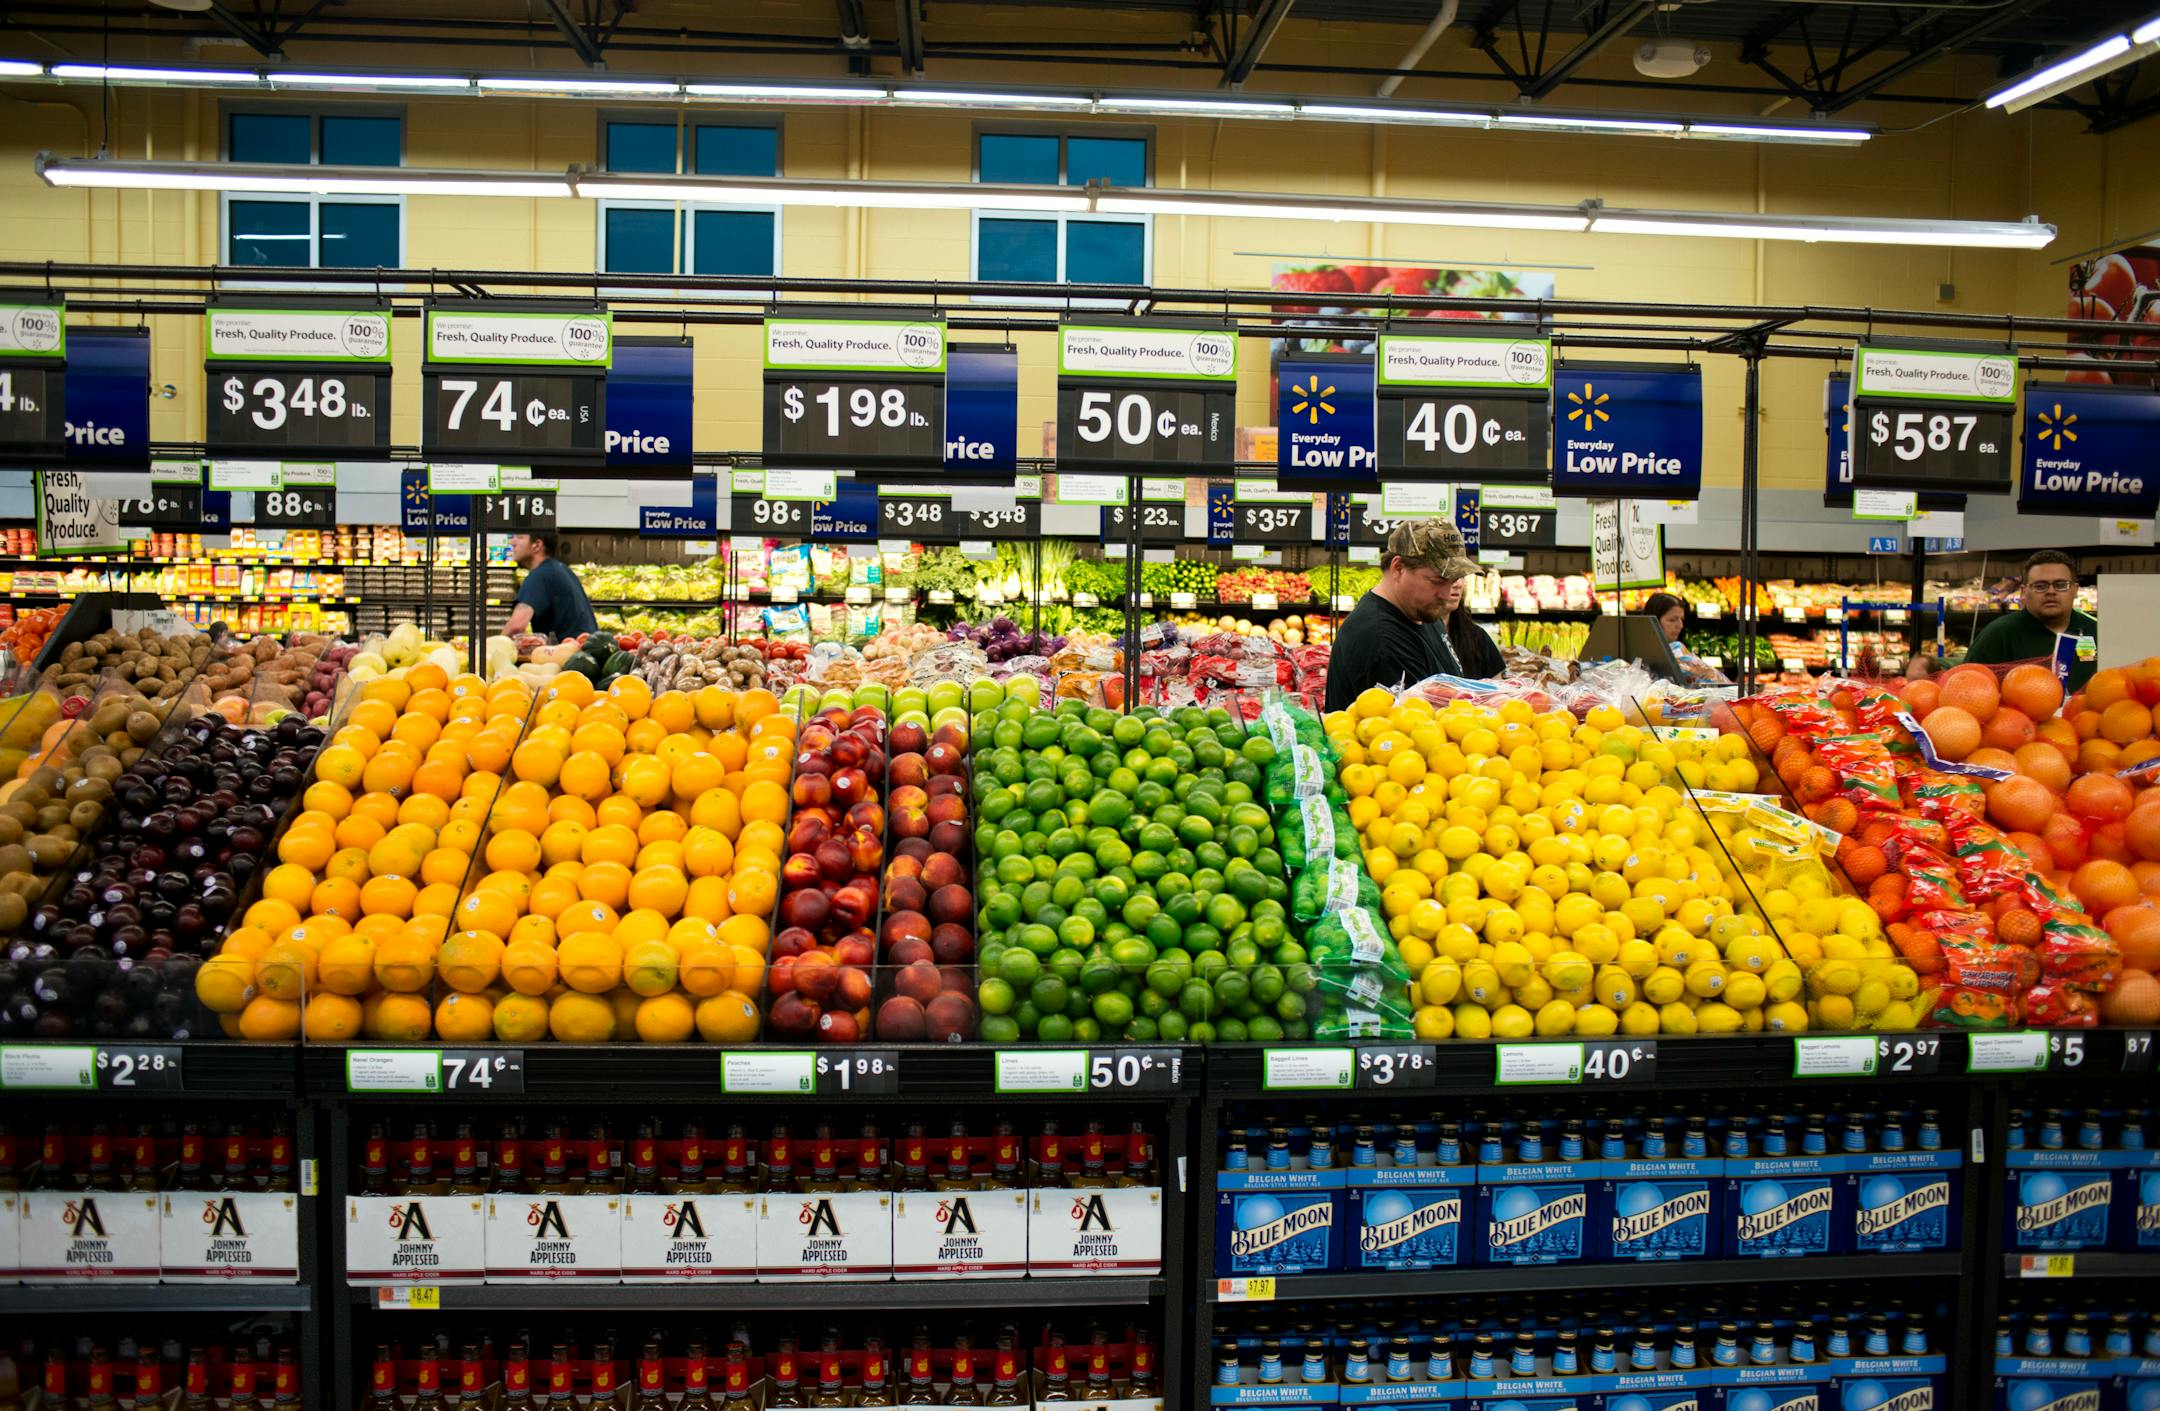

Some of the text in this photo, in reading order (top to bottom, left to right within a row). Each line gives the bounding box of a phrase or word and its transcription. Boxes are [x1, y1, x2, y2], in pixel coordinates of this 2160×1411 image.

[20, 317, 57, 333] 100%
[349, 324, 385, 340] 100%
[215, 328, 336, 342] Fresh, Quality Produce.
[436, 332, 557, 346] Fresh, Quality Produce.
[569, 327, 604, 344] 100%
[904, 334, 939, 350] 100%
[772, 338, 892, 352] Fresh, Quality Produce.
[1067, 344, 1184, 358] Fresh, Quality Produce.
[1196, 342, 1231, 358] 100%
[1388, 355, 1500, 368] Fresh, Quality Produce.
[1512, 352, 1544, 367] 100%
[1866, 366, 1970, 382] Fresh, Quality Produce.
[1980, 366, 2012, 381] 100%
[352, 403, 372, 418] lb.
[548, 407, 570, 421] ea.
[580, 405, 589, 424] USA
[910, 412, 929, 427] lb.
[1181, 424, 1202, 436] ea.
[1210, 412, 1219, 442] Mexico
[605, 430, 670, 454] Price
[1292, 433, 1340, 446] Everyday
[1505, 429, 1526, 441] ea.
[946, 436, 994, 460] rice
[1568, 440, 1614, 452] Everyday
[1979, 442, 1998, 454] ea.
[1291, 445, 1344, 467] Low
[1567, 452, 1682, 475] Low Price
[2036, 458, 2080, 471] Everyday
[2034, 470, 2144, 495] Low Price
[45, 494, 90, 516] Quality
[436, 514, 468, 526] Price
[646, 518, 706, 530] Low Price
[836, 521, 868, 533] Price
[1596, 512, 1618, 530] Fresh
[1872, 538, 1882, 550] A
[1172, 1058, 1181, 1084] Mexico
[1873, 1154, 1935, 1164] BELGIAN WHITE
[2033, 1152, 2098, 1162] BELGIAN WHITE
[1507, 1166, 1572, 1176] BELGIAN WHITE
[1630, 1162, 1696, 1172] BELGIAN WHITE
[1755, 1160, 1819, 1170] BELGIAN WHITE
[1248, 1174, 1318, 1183] BELGIAN WHITE
[1377, 1170, 1446, 1180] BELGIAN WHITE
[1857, 1186, 1948, 1236] BLUE MOON
[2017, 1184, 2109, 1231] BLUE MOON
[1489, 1197, 1584, 1248] BLUE MOON
[1613, 1194, 1708, 1243] BLUE MOON
[1738, 1190, 1831, 1241] BLUE MOON
[1232, 1206, 1330, 1256] BLUE MOON
[1360, 1202, 1458, 1251] BLUE MOON
[71, 1239, 108, 1251] JOHNNY
[211, 1239, 248, 1251] JOHNNY
[535, 1241, 570, 1252] JOHNNY
[671, 1240, 707, 1251] JOHNNY
[807, 1239, 842, 1250] JOHNNY
[944, 1236, 978, 1248] JOHNNY
[1078, 1234, 1113, 1246] JOHNNY
[397, 1243, 434, 1254] JOHNNY
[802, 1248, 848, 1262] APPLESEED
[938, 1246, 984, 1260] APPLESEED
[1072, 1244, 1118, 1257] APPLESEED
[66, 1250, 114, 1264] APPLESEED
[206, 1249, 252, 1263] APPLESEED
[392, 1252, 439, 1266] APPLESEED
[530, 1250, 576, 1264] APPLESEED
[666, 1250, 712, 1264] APPLESEED
[1249, 1280, 1269, 1293] $7.97
[412, 1288, 434, 1301] $8.47
